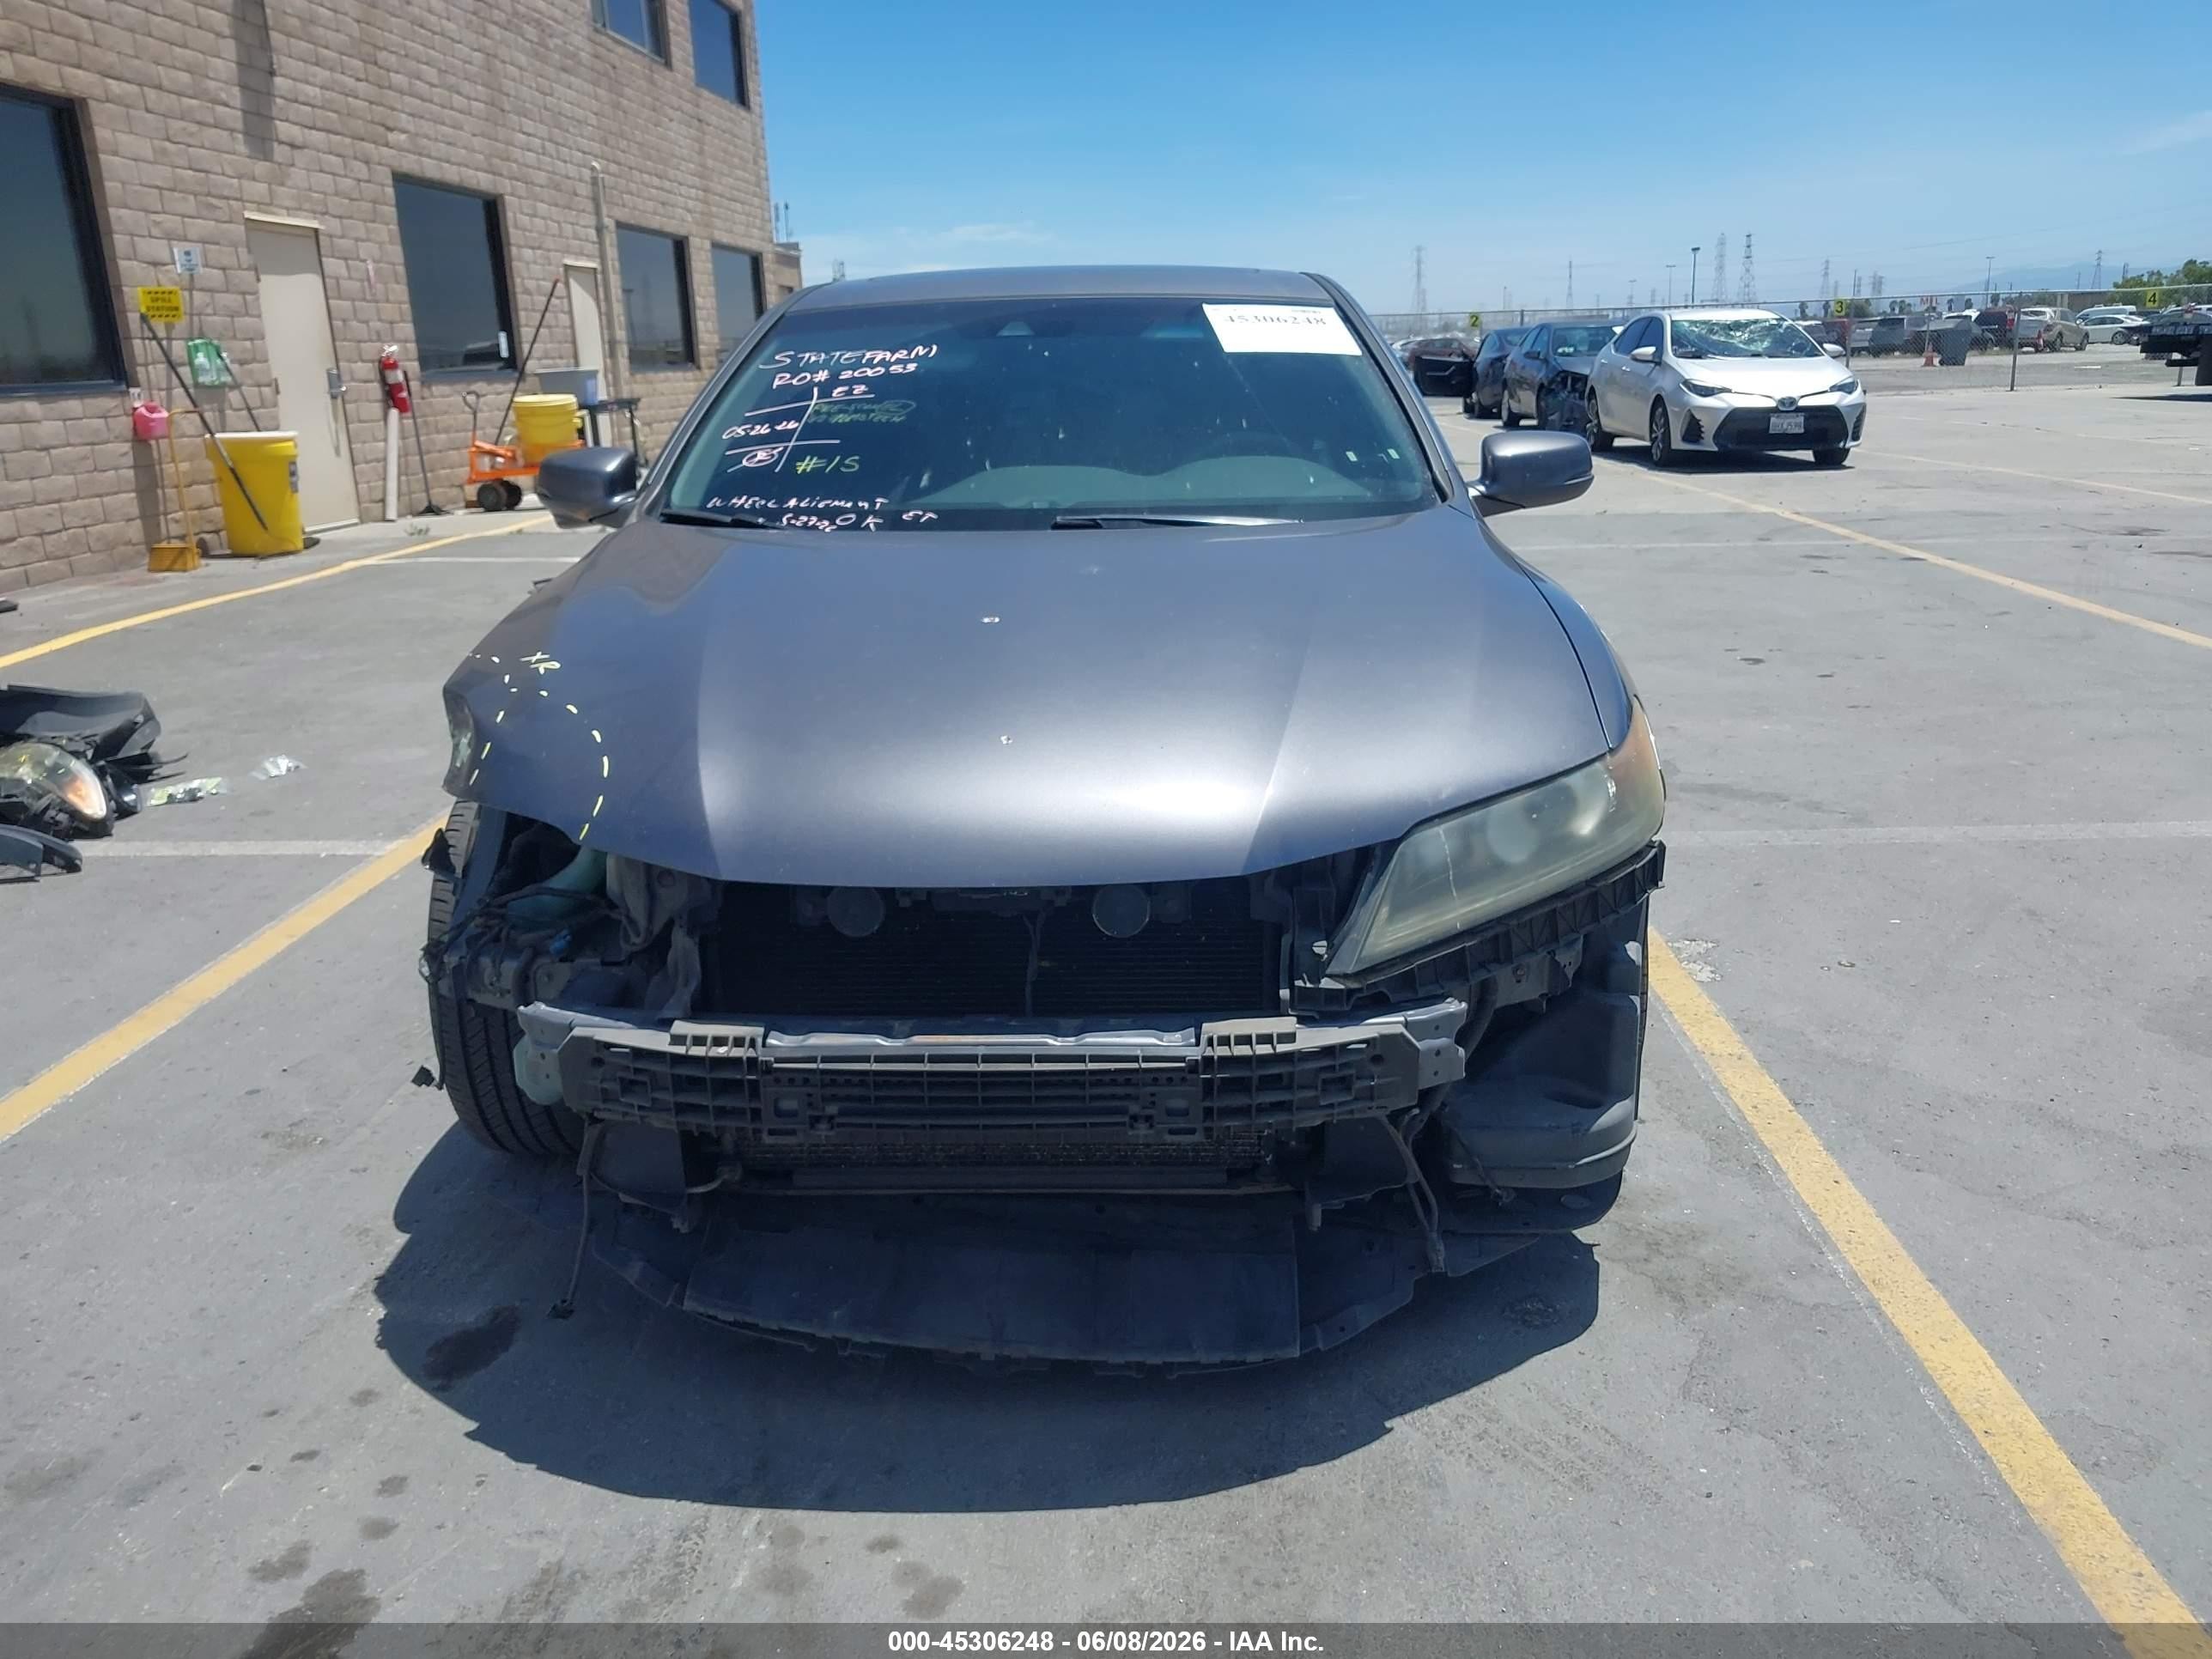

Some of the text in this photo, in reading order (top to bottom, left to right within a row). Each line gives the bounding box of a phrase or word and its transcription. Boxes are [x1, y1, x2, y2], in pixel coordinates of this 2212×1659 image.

[2148, 291, 2157, 305] 4
[1835, 301, 1844, 313] 3
[1469, 314, 1479, 327] 2
